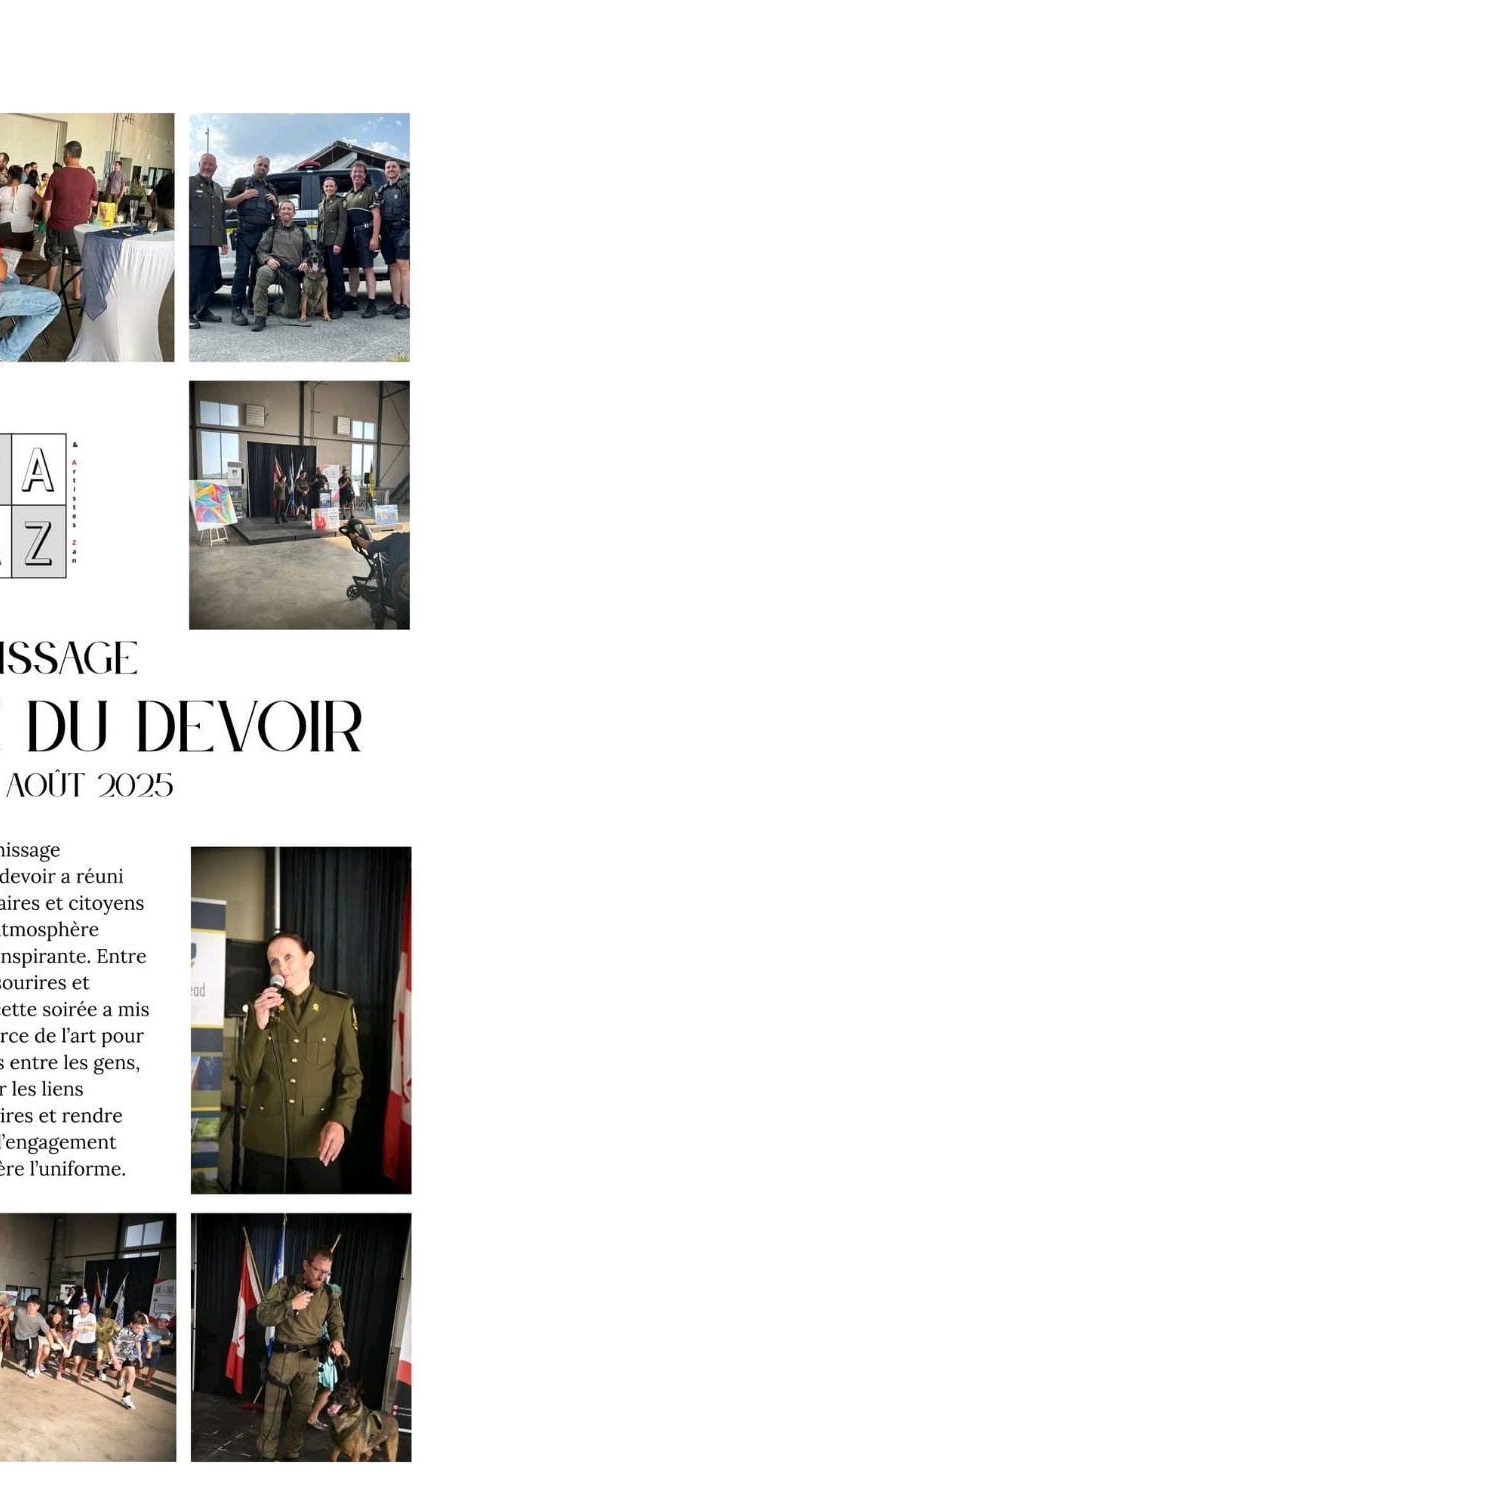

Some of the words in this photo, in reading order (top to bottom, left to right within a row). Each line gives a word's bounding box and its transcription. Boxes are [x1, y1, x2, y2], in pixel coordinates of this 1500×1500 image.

[27, 699, 108, 753] DU
[137, 699, 363, 753] DEVOIR
[5, 768, 86, 798] AOÛT
[97, 772, 174, 798] 2025
[60, 872, 71, 884] a
[76, 867, 124, 885] réuni
[45, 896, 64, 911] et
[68, 894, 145, 916] citoyens
[96, 948, 147, 964] Entre
[71, 976, 91, 991] et
[42, 1000, 98, 1017] soirée
[102, 1005, 113, 1017] a
[117, 1001, 150, 1017] mis
[34, 1027, 57, 1044] de
[101, 1031, 145, 1048] pour
[9, 1056, 59, 1071] entre
[63, 1053, 89, 1071] les
[93, 1057, 140, 1076] gens,
[11, 1079, 37, 1097] les
[41, 1080, 84, 1097] liens
[38, 1109, 57, 1124] et
[61, 1107, 123, 1124] rendre
